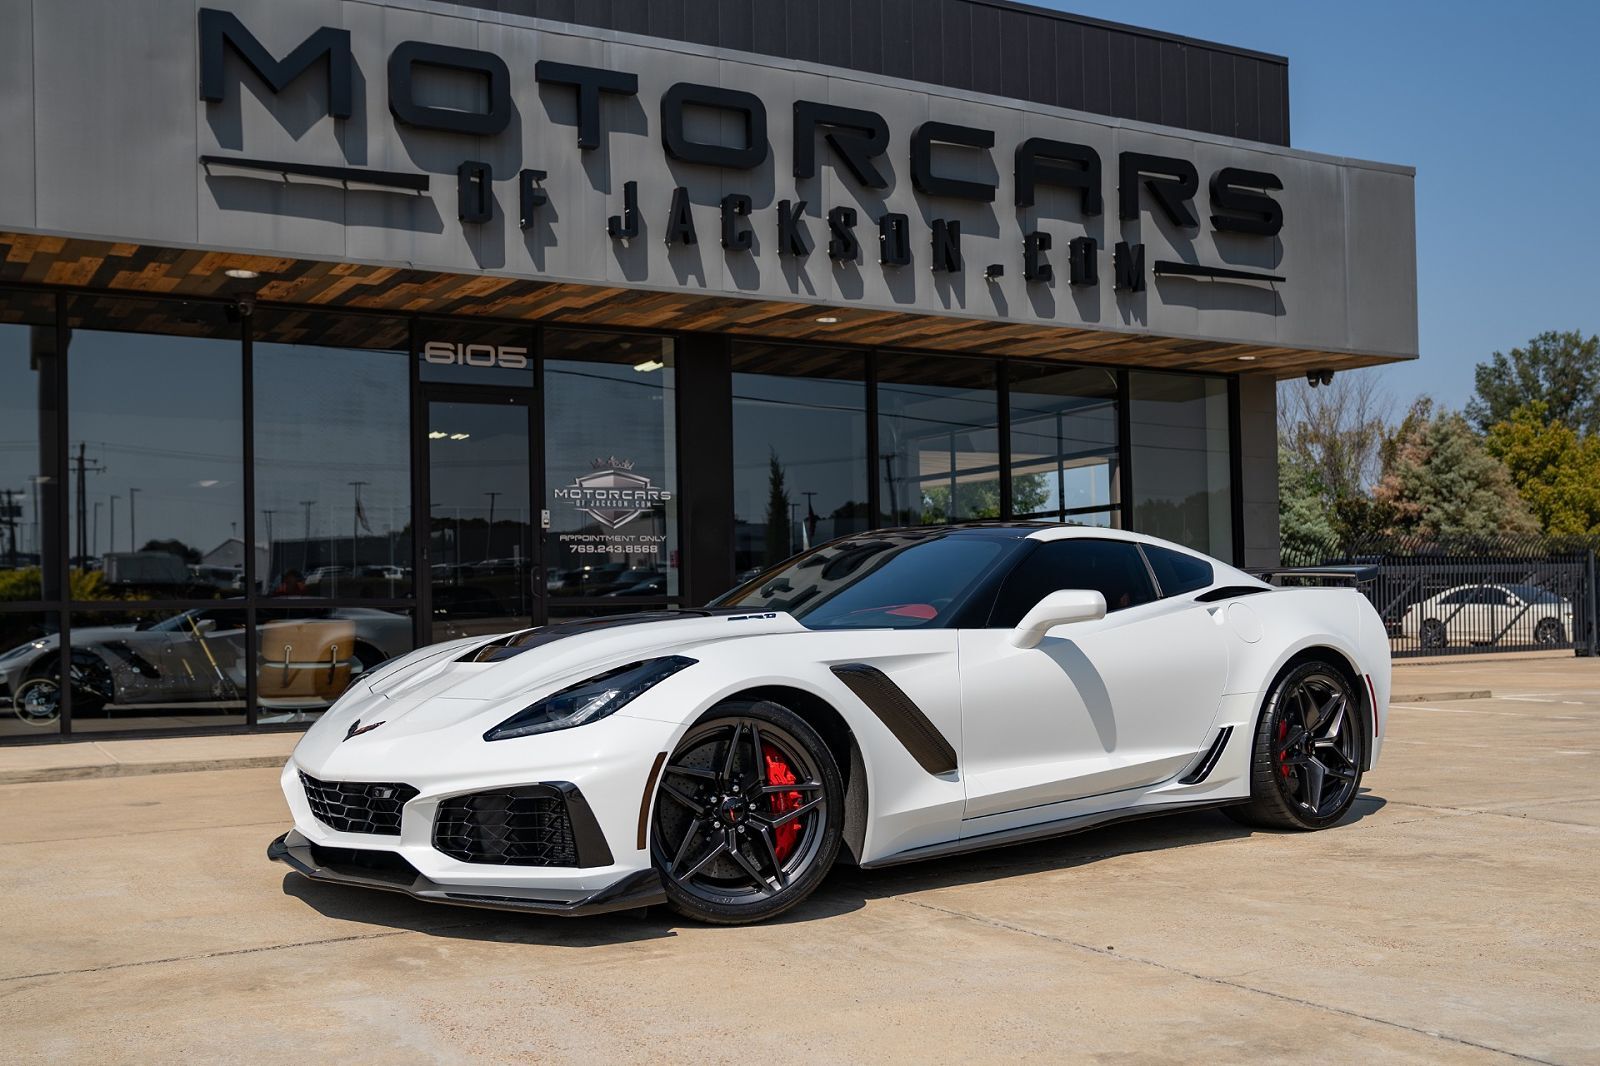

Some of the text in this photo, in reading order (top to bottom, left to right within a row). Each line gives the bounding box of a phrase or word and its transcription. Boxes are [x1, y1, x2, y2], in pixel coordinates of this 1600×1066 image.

[199, 7, 1284, 236] MOTORCARS
[457, 160, 547, 230] OF
[425, 341, 528, 369] 6105
[554, 489, 672, 500] MOTORCARS
[559, 534, 636, 542] APPOINTMENT
[569, 545, 658, 553] 769.243.8568
